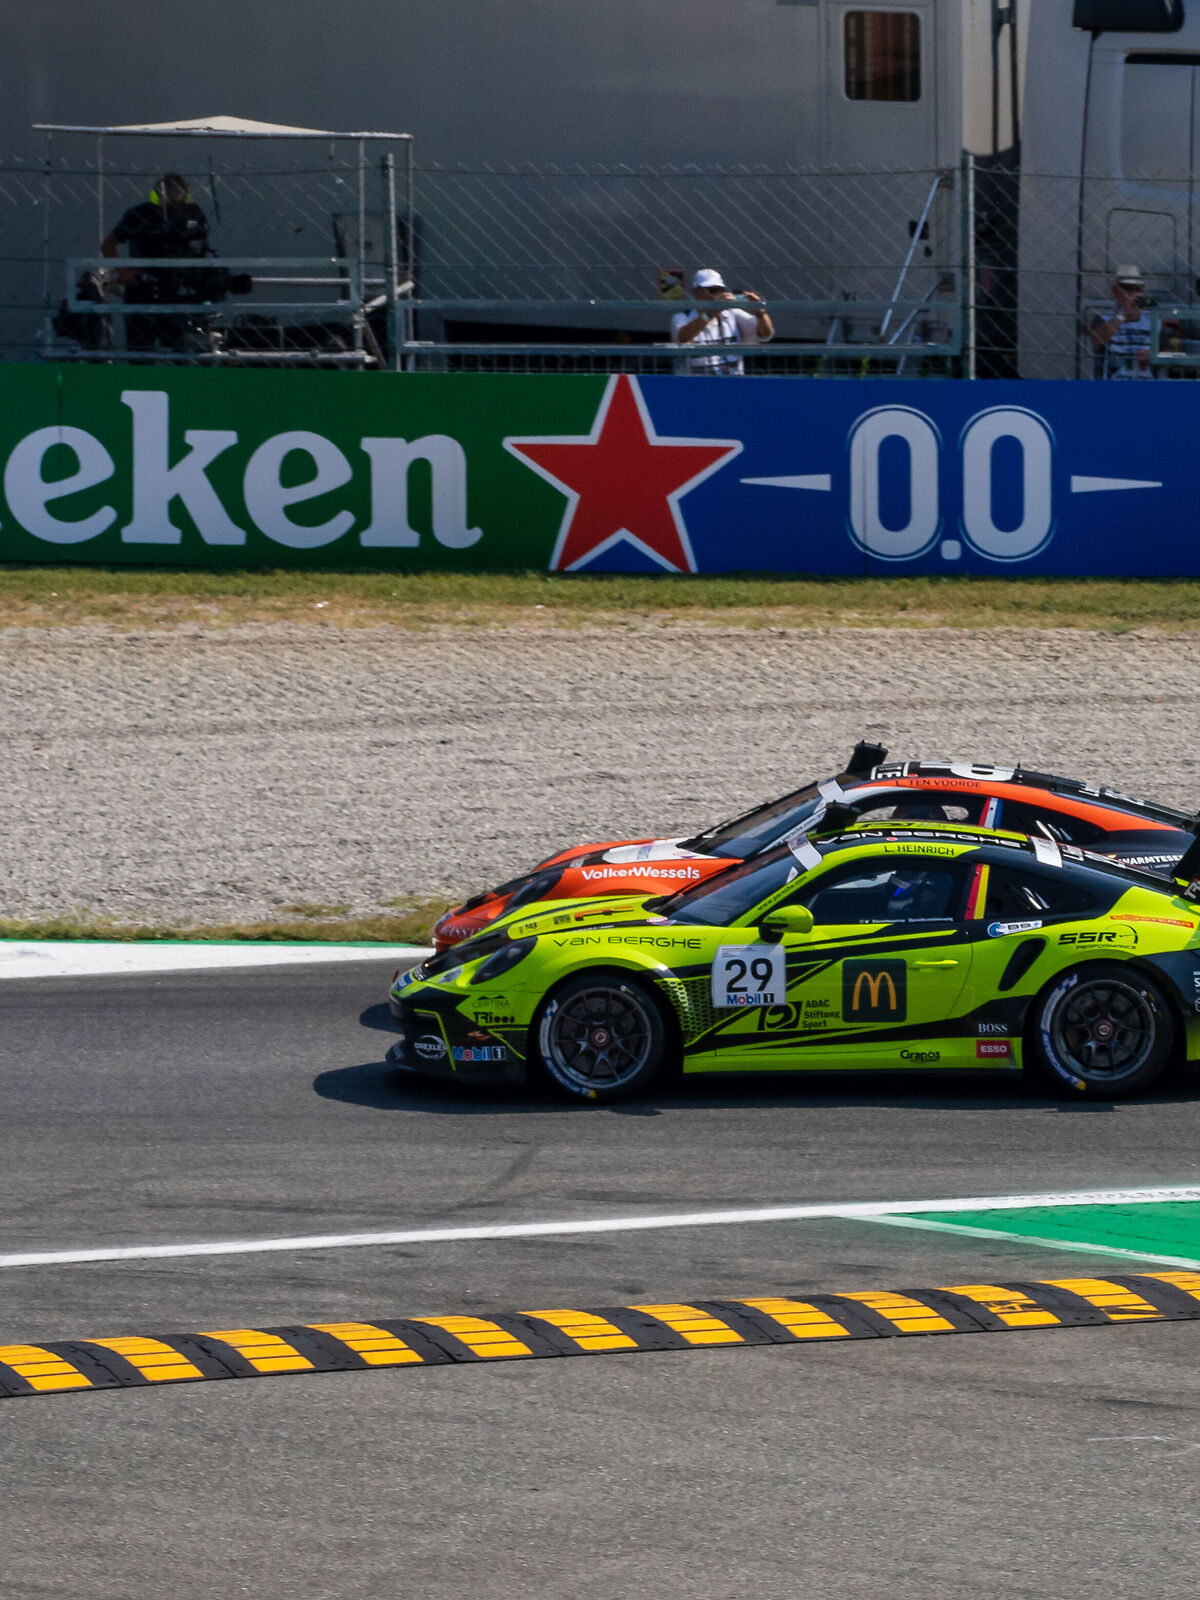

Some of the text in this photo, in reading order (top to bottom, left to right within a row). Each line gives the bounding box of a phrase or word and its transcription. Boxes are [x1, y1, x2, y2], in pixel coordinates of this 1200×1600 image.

[3, 389, 484, 549] eken
[848, 404, 1053, 561] 0.0
[909, 779, 930, 787] TEN
[935, 780, 981, 789] VOORDE
[898, 845, 954, 857] HEINRICH
[581, 867, 701, 881] VolkerWessels
[608, 936, 702, 949] BERGHE
[1058, 932, 1117, 946] SSR
[725, 958, 773, 993] 29
[727, 993, 774, 1005] Mobil 1
[805, 1000, 830, 1008] ADAC
[804, 1011, 840, 1019] Stiftung
[802, 1020, 828, 1029] Sport
[978, 1024, 1008, 1033] BOSS
[452, 1046, 490, 1061] Mobil
[980, 1045, 1008, 1053] ESSO
